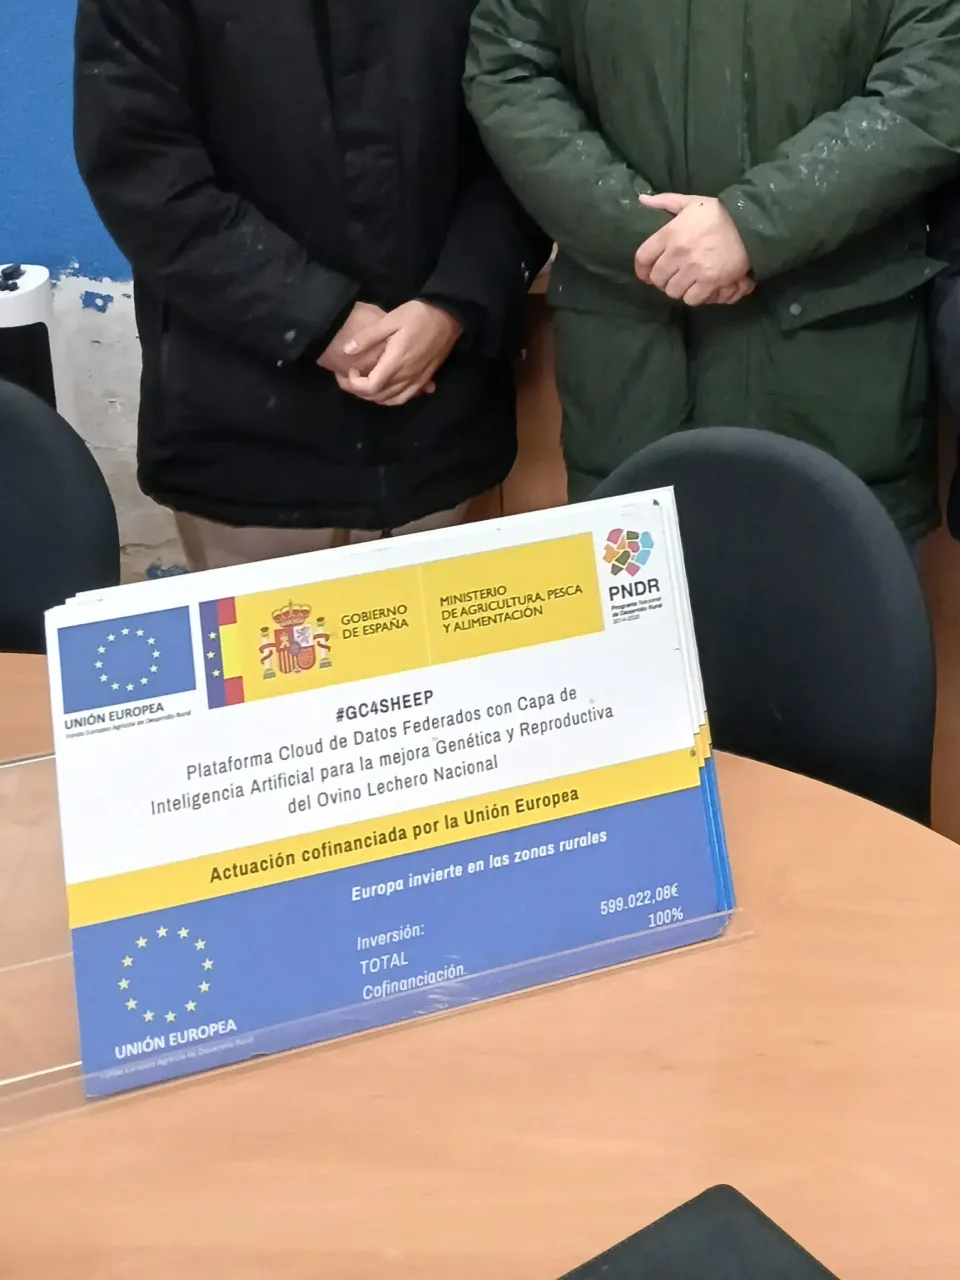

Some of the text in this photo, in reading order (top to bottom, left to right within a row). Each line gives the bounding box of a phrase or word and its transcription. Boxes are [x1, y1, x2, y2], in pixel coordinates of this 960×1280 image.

[440, 585, 507, 607] MINISTERIO
[441, 584, 584, 621] DE AGRICULTURA, PESCA
[609, 578, 660, 601] PNDR
[341, 604, 408, 626] GOBIERNO
[342, 617, 409, 639] DE ESPAÑA
[443, 605, 544, 634] Y ALIMENTACIÓN
[64, 702, 165, 730] UNIÓN EUROPEA
[336, 689, 434, 723] #GC4SHEEP
[186, 686, 578, 781] Plataforma Cloud de Datos Federados con Capa de
[151, 705, 614, 816] Inteligencia Artificial para la mejora Genética y Reproductiva
[288, 754, 498, 814] del Ovino Lechero Nacional
[210, 787, 579, 883] Actuación cofinanciada por la Unión Europea
[351, 830, 608, 901] Europa invierte en las zonas rurales
[600, 883, 679, 916] 599.022,08€
[648, 906, 684, 928] 100%
[357, 922, 425, 951] Inversión:
[360, 951, 408, 975] TOTAL
[114, 1035, 165, 1059] UNIÓN
[169, 1018, 237, 1046] EUROPEA
